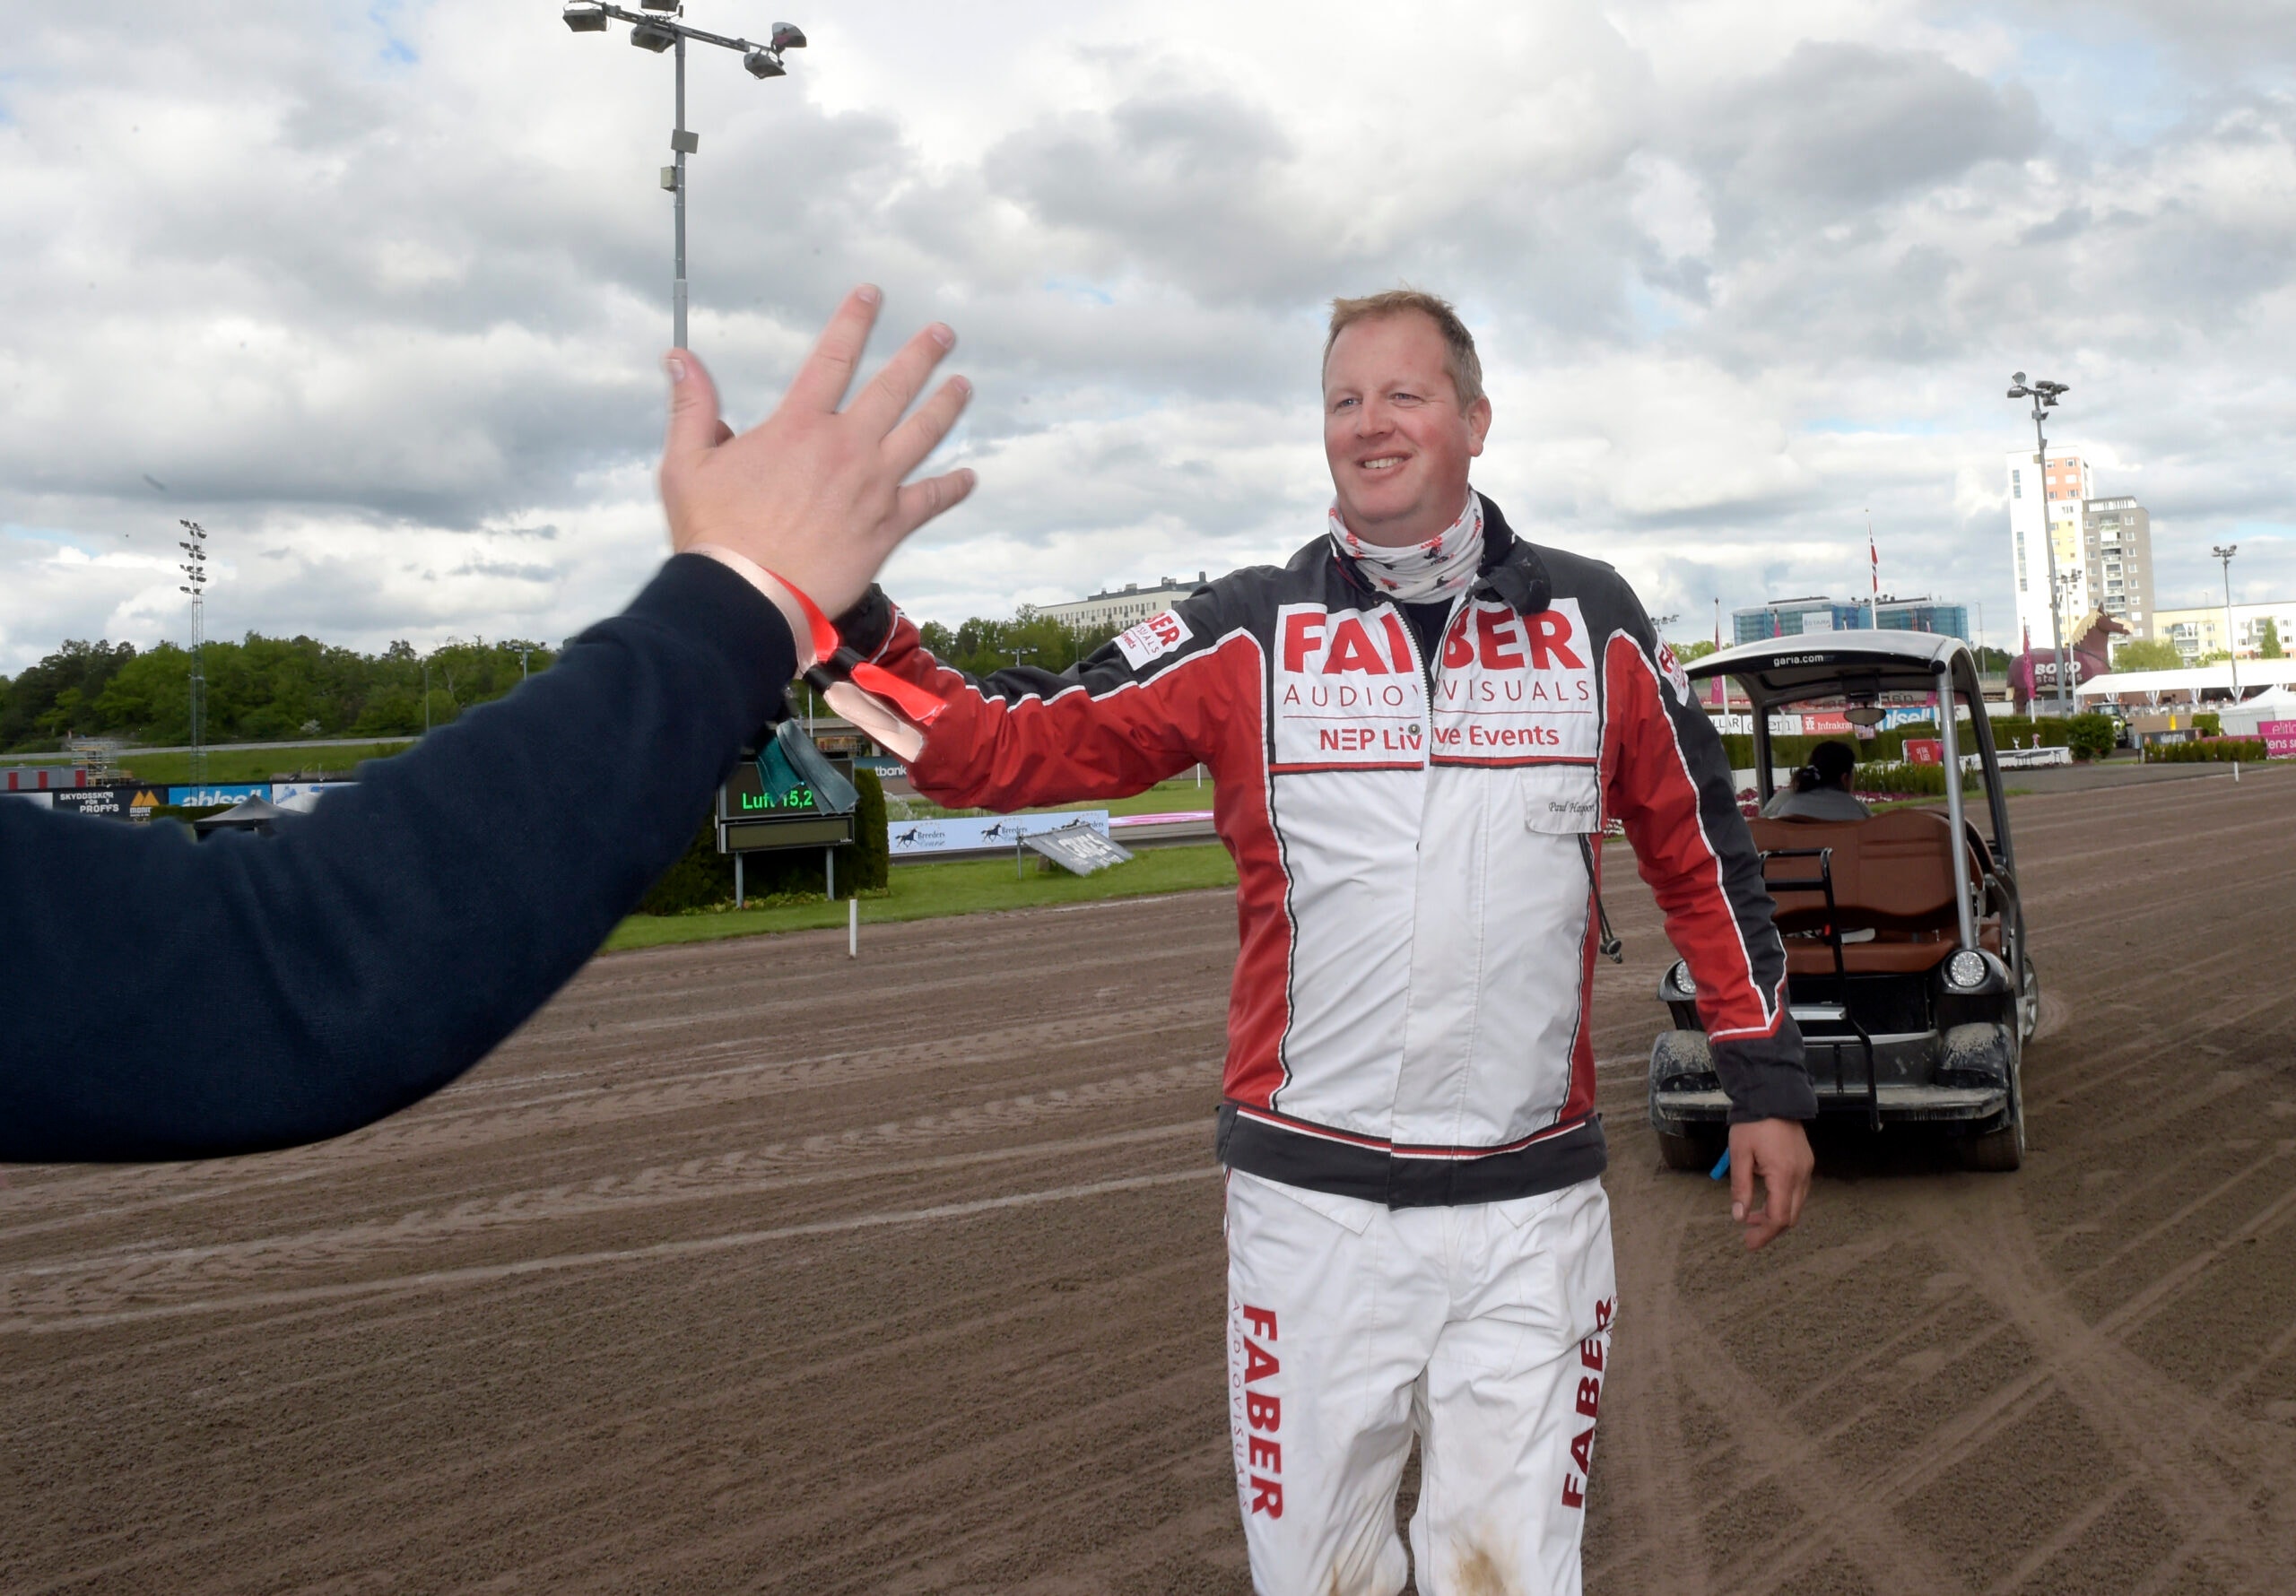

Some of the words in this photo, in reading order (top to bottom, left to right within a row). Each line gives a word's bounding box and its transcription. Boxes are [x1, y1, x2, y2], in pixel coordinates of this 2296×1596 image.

[1773, 655, 1824, 667] garia.com
[1468, 724, 1561, 746] Events
[79, 803, 119, 813] PROFFS
[1243, 1304, 1284, 1521] FABER
[1561, 1295, 1613, 1509] FABER
